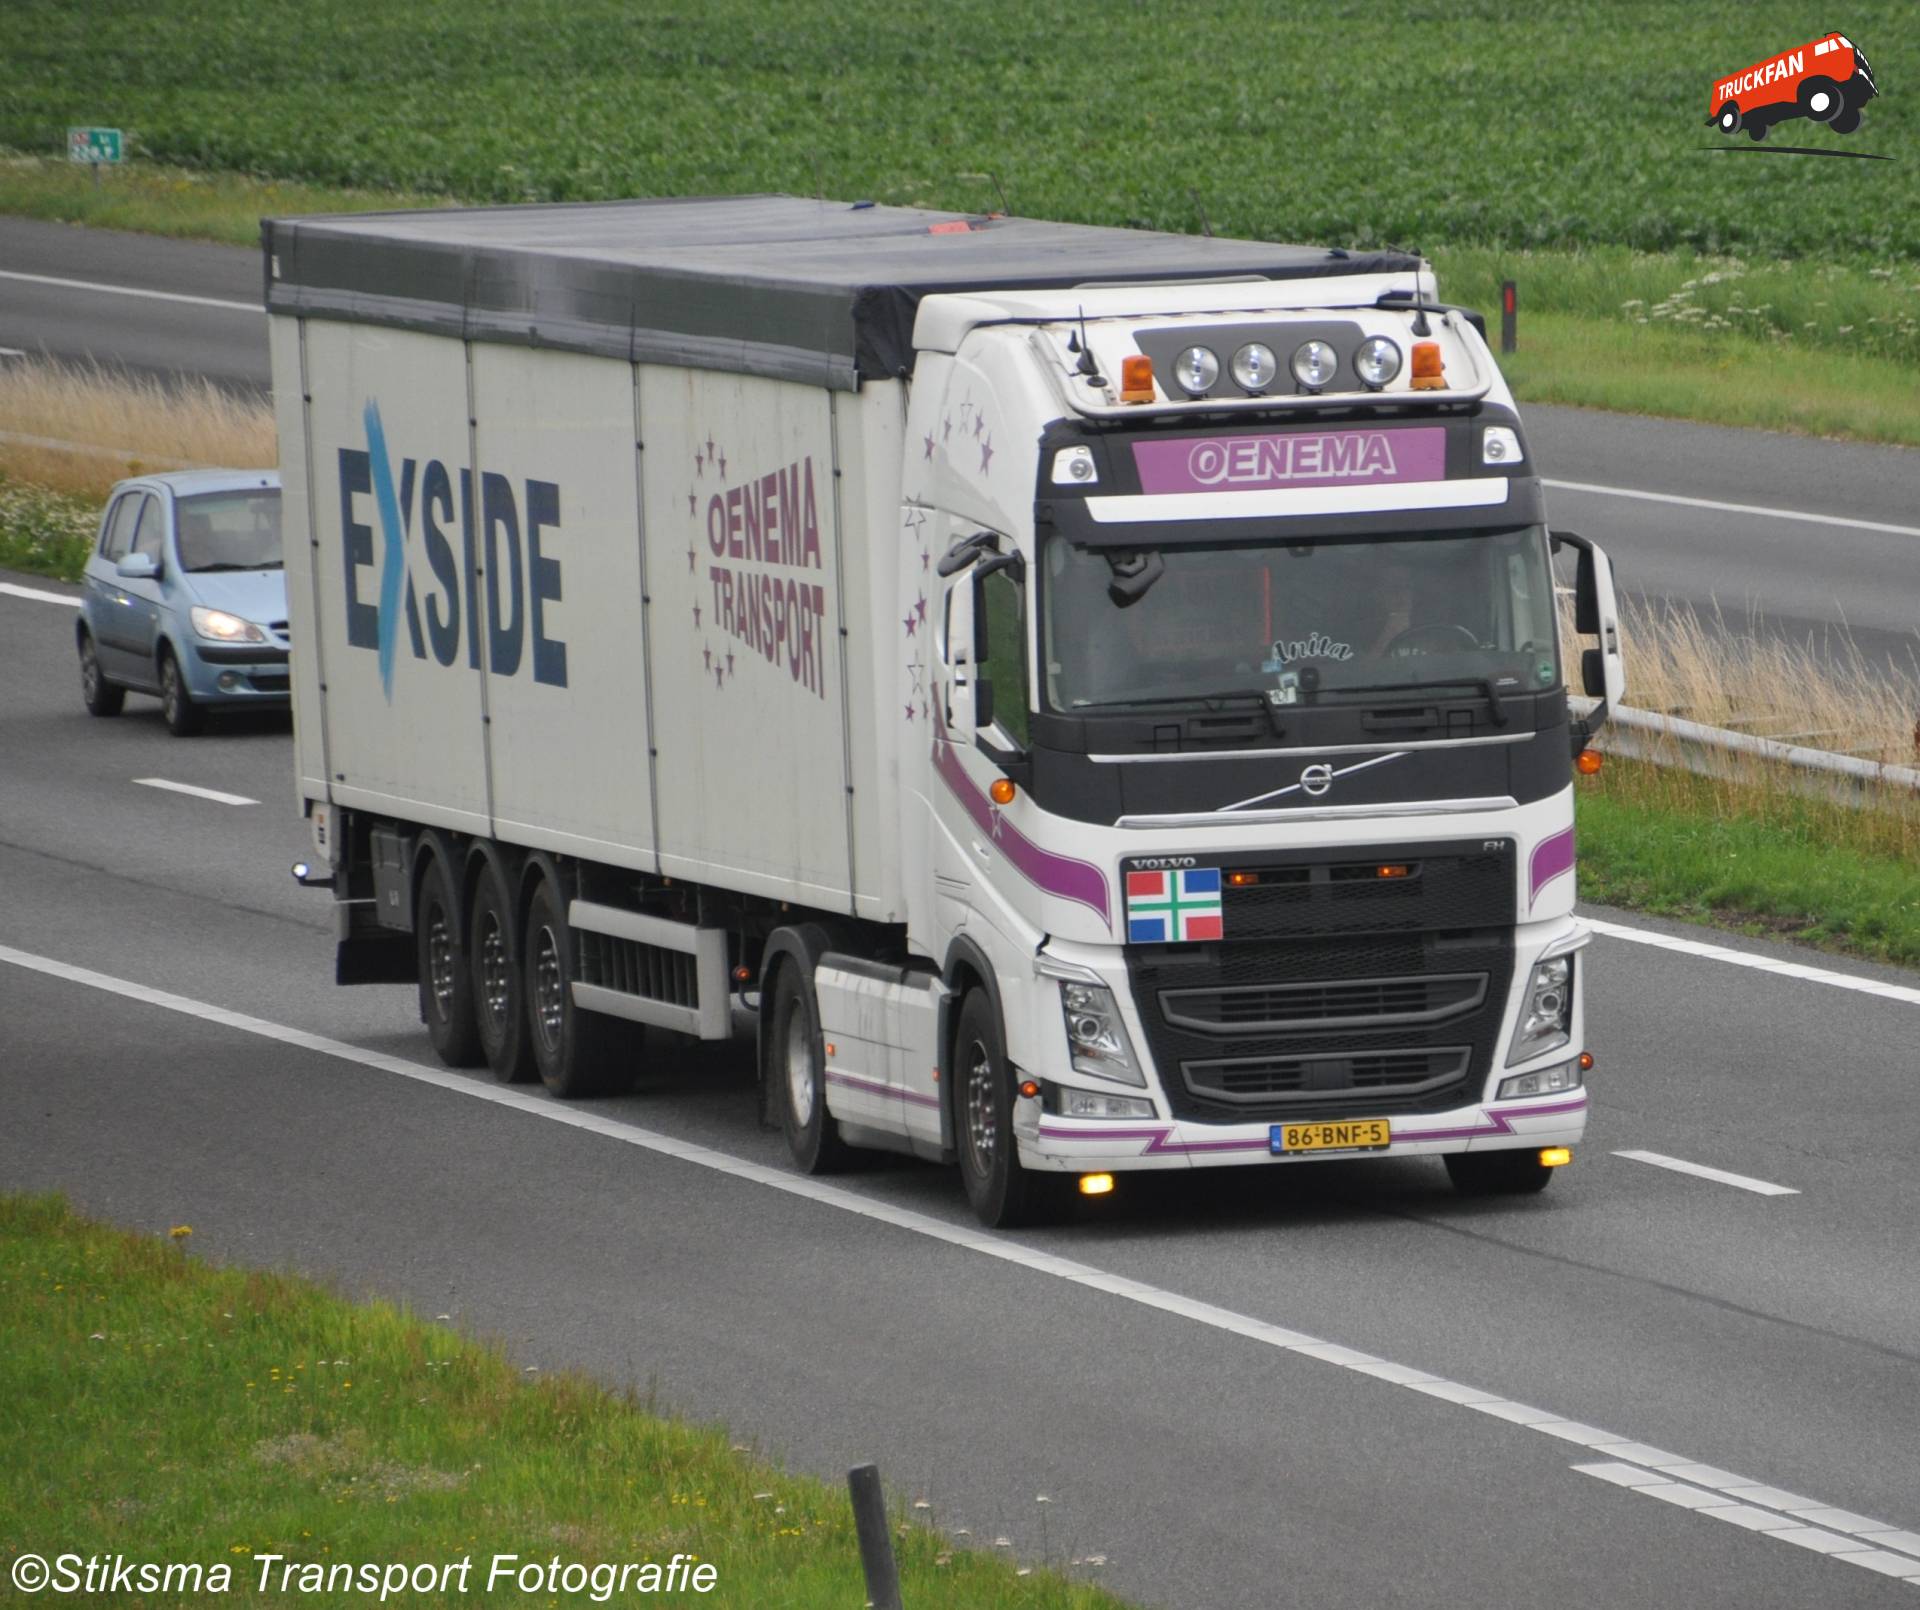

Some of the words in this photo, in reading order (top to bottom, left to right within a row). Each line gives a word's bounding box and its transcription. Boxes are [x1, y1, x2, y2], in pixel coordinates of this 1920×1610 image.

[1188, 434, 1398, 486] OENEMA
[707, 456, 821, 570] OENEMA
[338, 446, 568, 689] EXSIDE
[710, 566, 825, 701] TRANSPORT
[1272, 631, 1354, 664] Anita
[1130, 857, 1197, 870] VOLVO
[1287, 1124, 1382, 1146] 86-BNF-5
